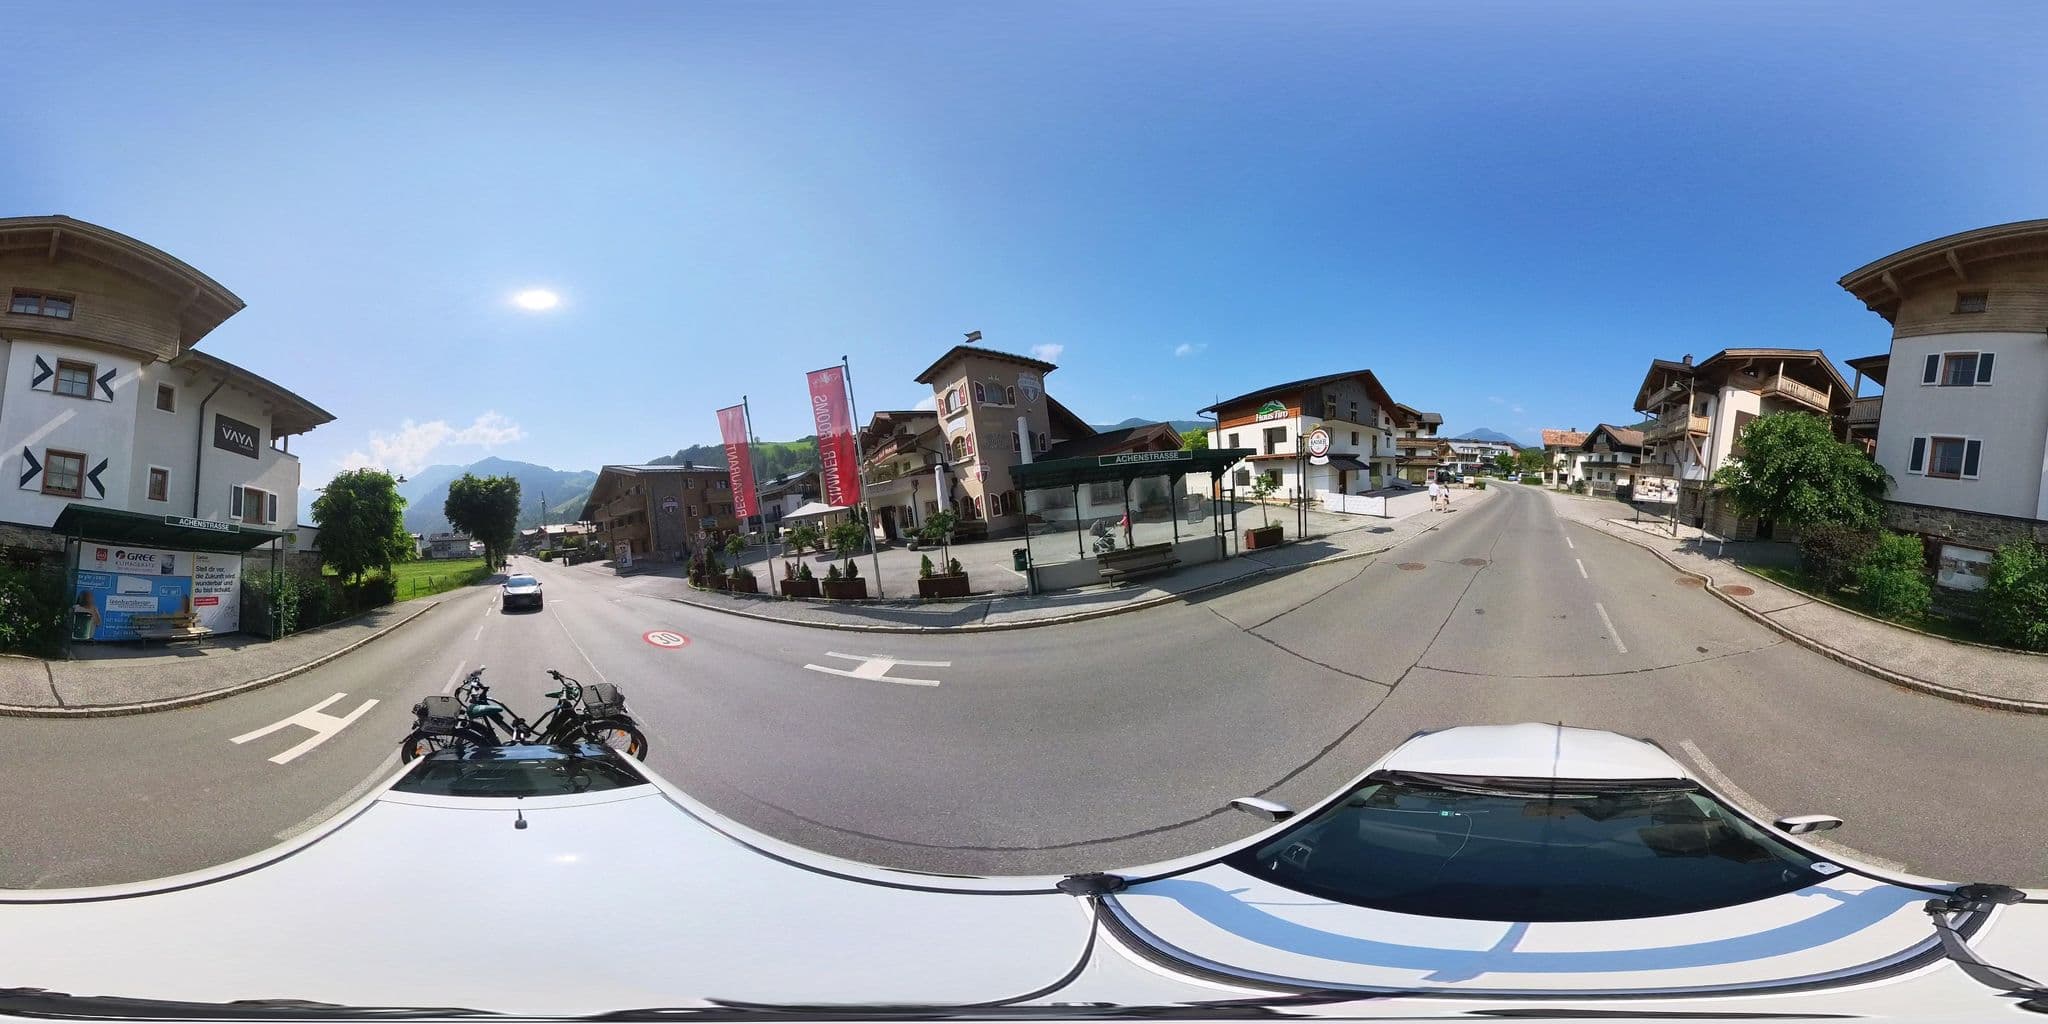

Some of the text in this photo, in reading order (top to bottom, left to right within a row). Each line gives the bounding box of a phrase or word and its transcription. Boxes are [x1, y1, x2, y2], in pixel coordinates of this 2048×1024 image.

[222, 427, 254, 448] VAYA
[1116, 452, 1178, 463] ACHENSTRASSE
[179, 518, 230, 530] ACHENSTRASSE
[127, 552, 156, 562] GREE
[651, 633, 681, 644] 30
